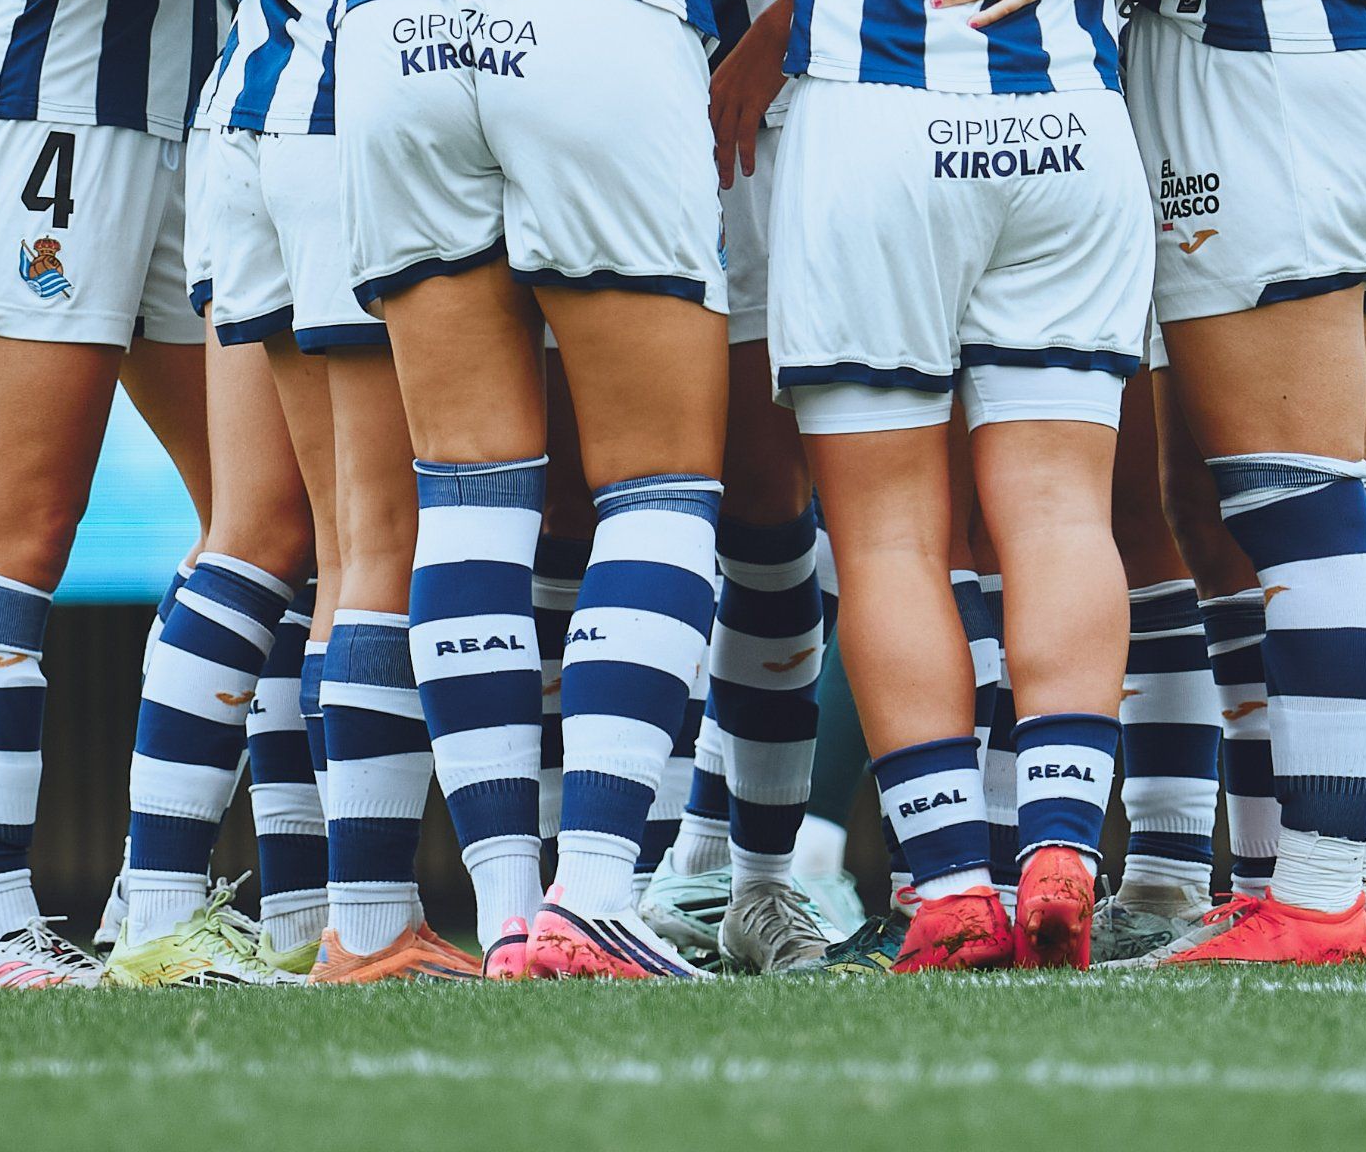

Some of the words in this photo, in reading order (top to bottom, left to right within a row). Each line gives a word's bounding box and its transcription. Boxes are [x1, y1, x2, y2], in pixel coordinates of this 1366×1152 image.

[400, 41, 529, 79] KIROAK
[928, 112, 1087, 146] GIPUZKOA
[934, 143, 1085, 179] KIROLAK
[1161, 158, 1176, 179] EL
[21, 130, 75, 229] 4
[1160, 172, 1220, 199] DIARIO
[1160, 195, 1220, 221] VASCO
[436, 634, 525, 656] REAL
[1026, 763, 1095, 783] REAL
[898, 789, 968, 818] REAL
